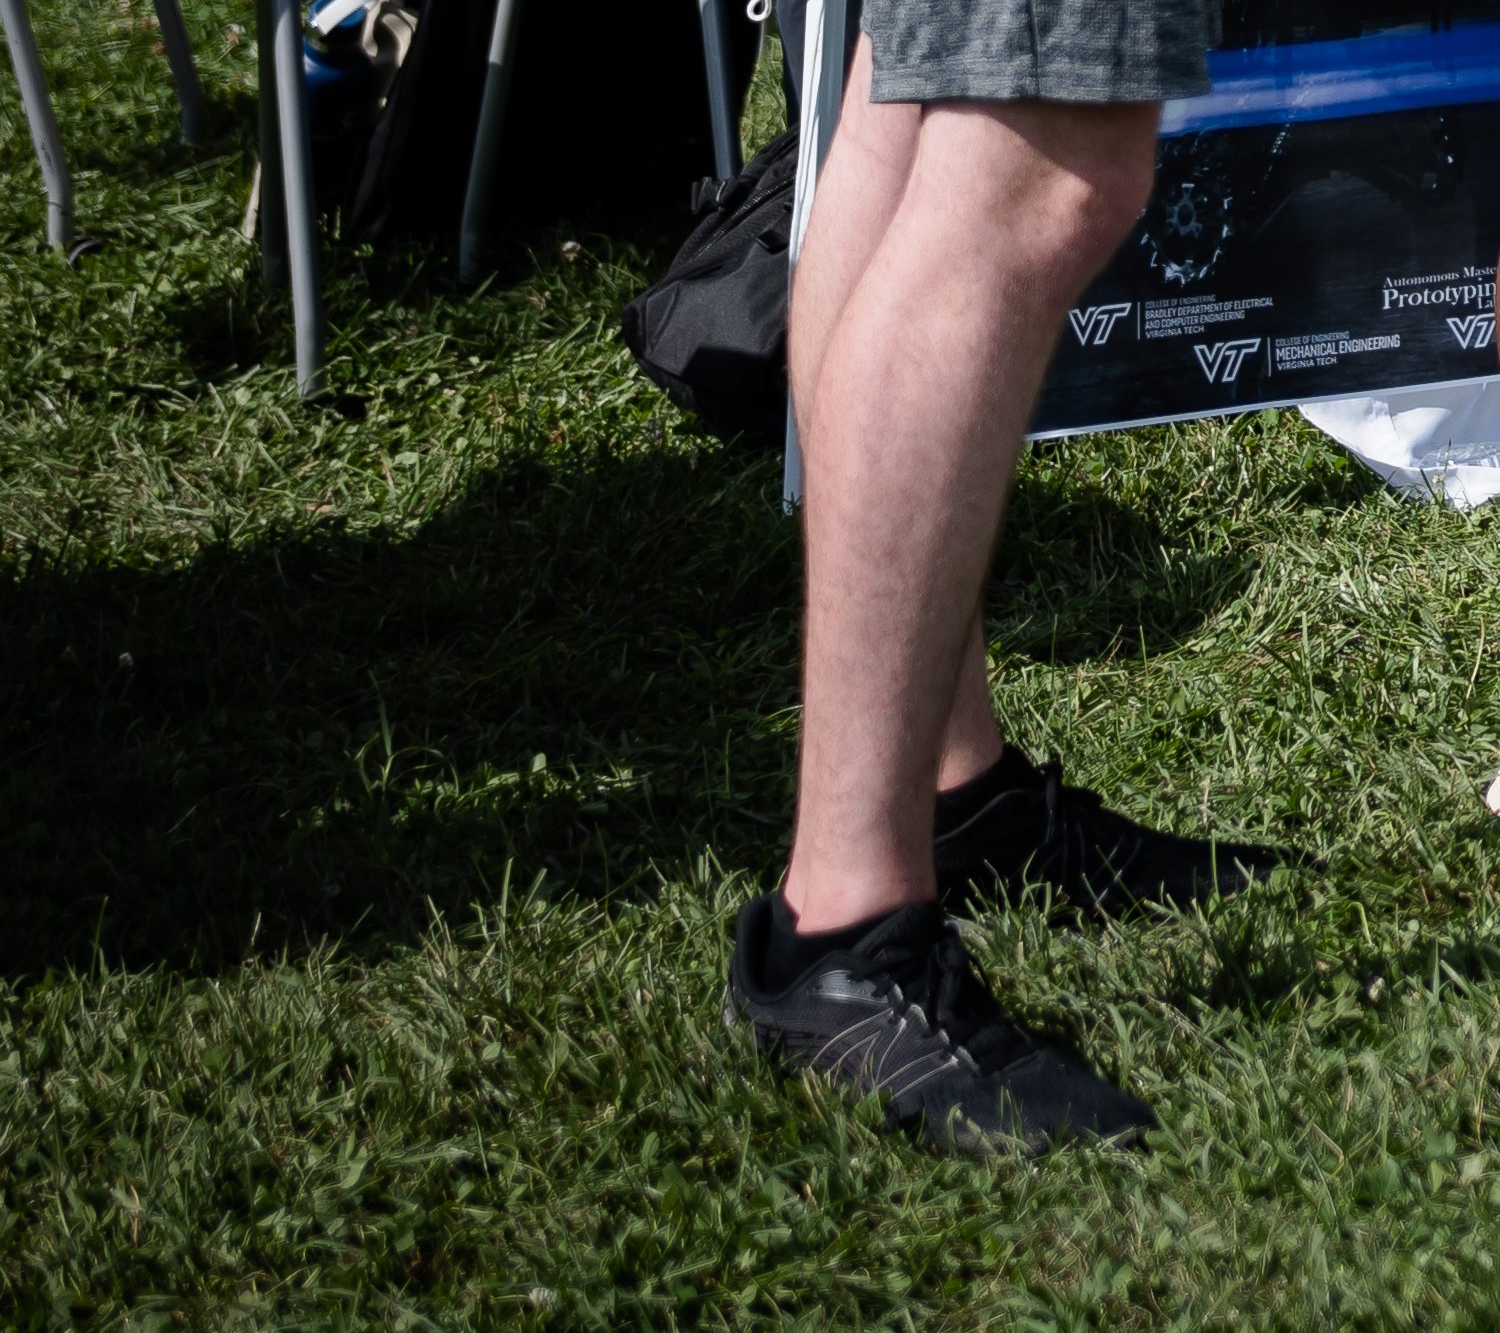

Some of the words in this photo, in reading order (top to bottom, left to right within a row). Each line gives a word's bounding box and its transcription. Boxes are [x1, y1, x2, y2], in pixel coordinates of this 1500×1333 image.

[1383, 271, 1460, 288] Autonomous
[1145, 308, 1177, 320] BRADLEY
[1178, 303, 1223, 316] DEPARTMENT
[1224, 301, 1233, 311] OF
[1234, 297, 1274, 309] ELECTRICAL
[1145, 320, 1160, 330] AND
[1162, 315, 1199, 327] COMPUTER
[1200, 310, 1245, 324] ENGINEERING
[1145, 327, 1182, 338] VIRGINIA
[1184, 324, 1205, 334] TECH
[1275, 343, 1338, 361] MECHANICAL
[1339, 334, 1401, 354] ENGINEERING
[1276, 337, 1301, 347] COLLEGE
[1302, 335, 1310, 344] OF
[1277, 359, 1315, 371] VIRGINIA
[1317, 357, 1337, 366] TECH
